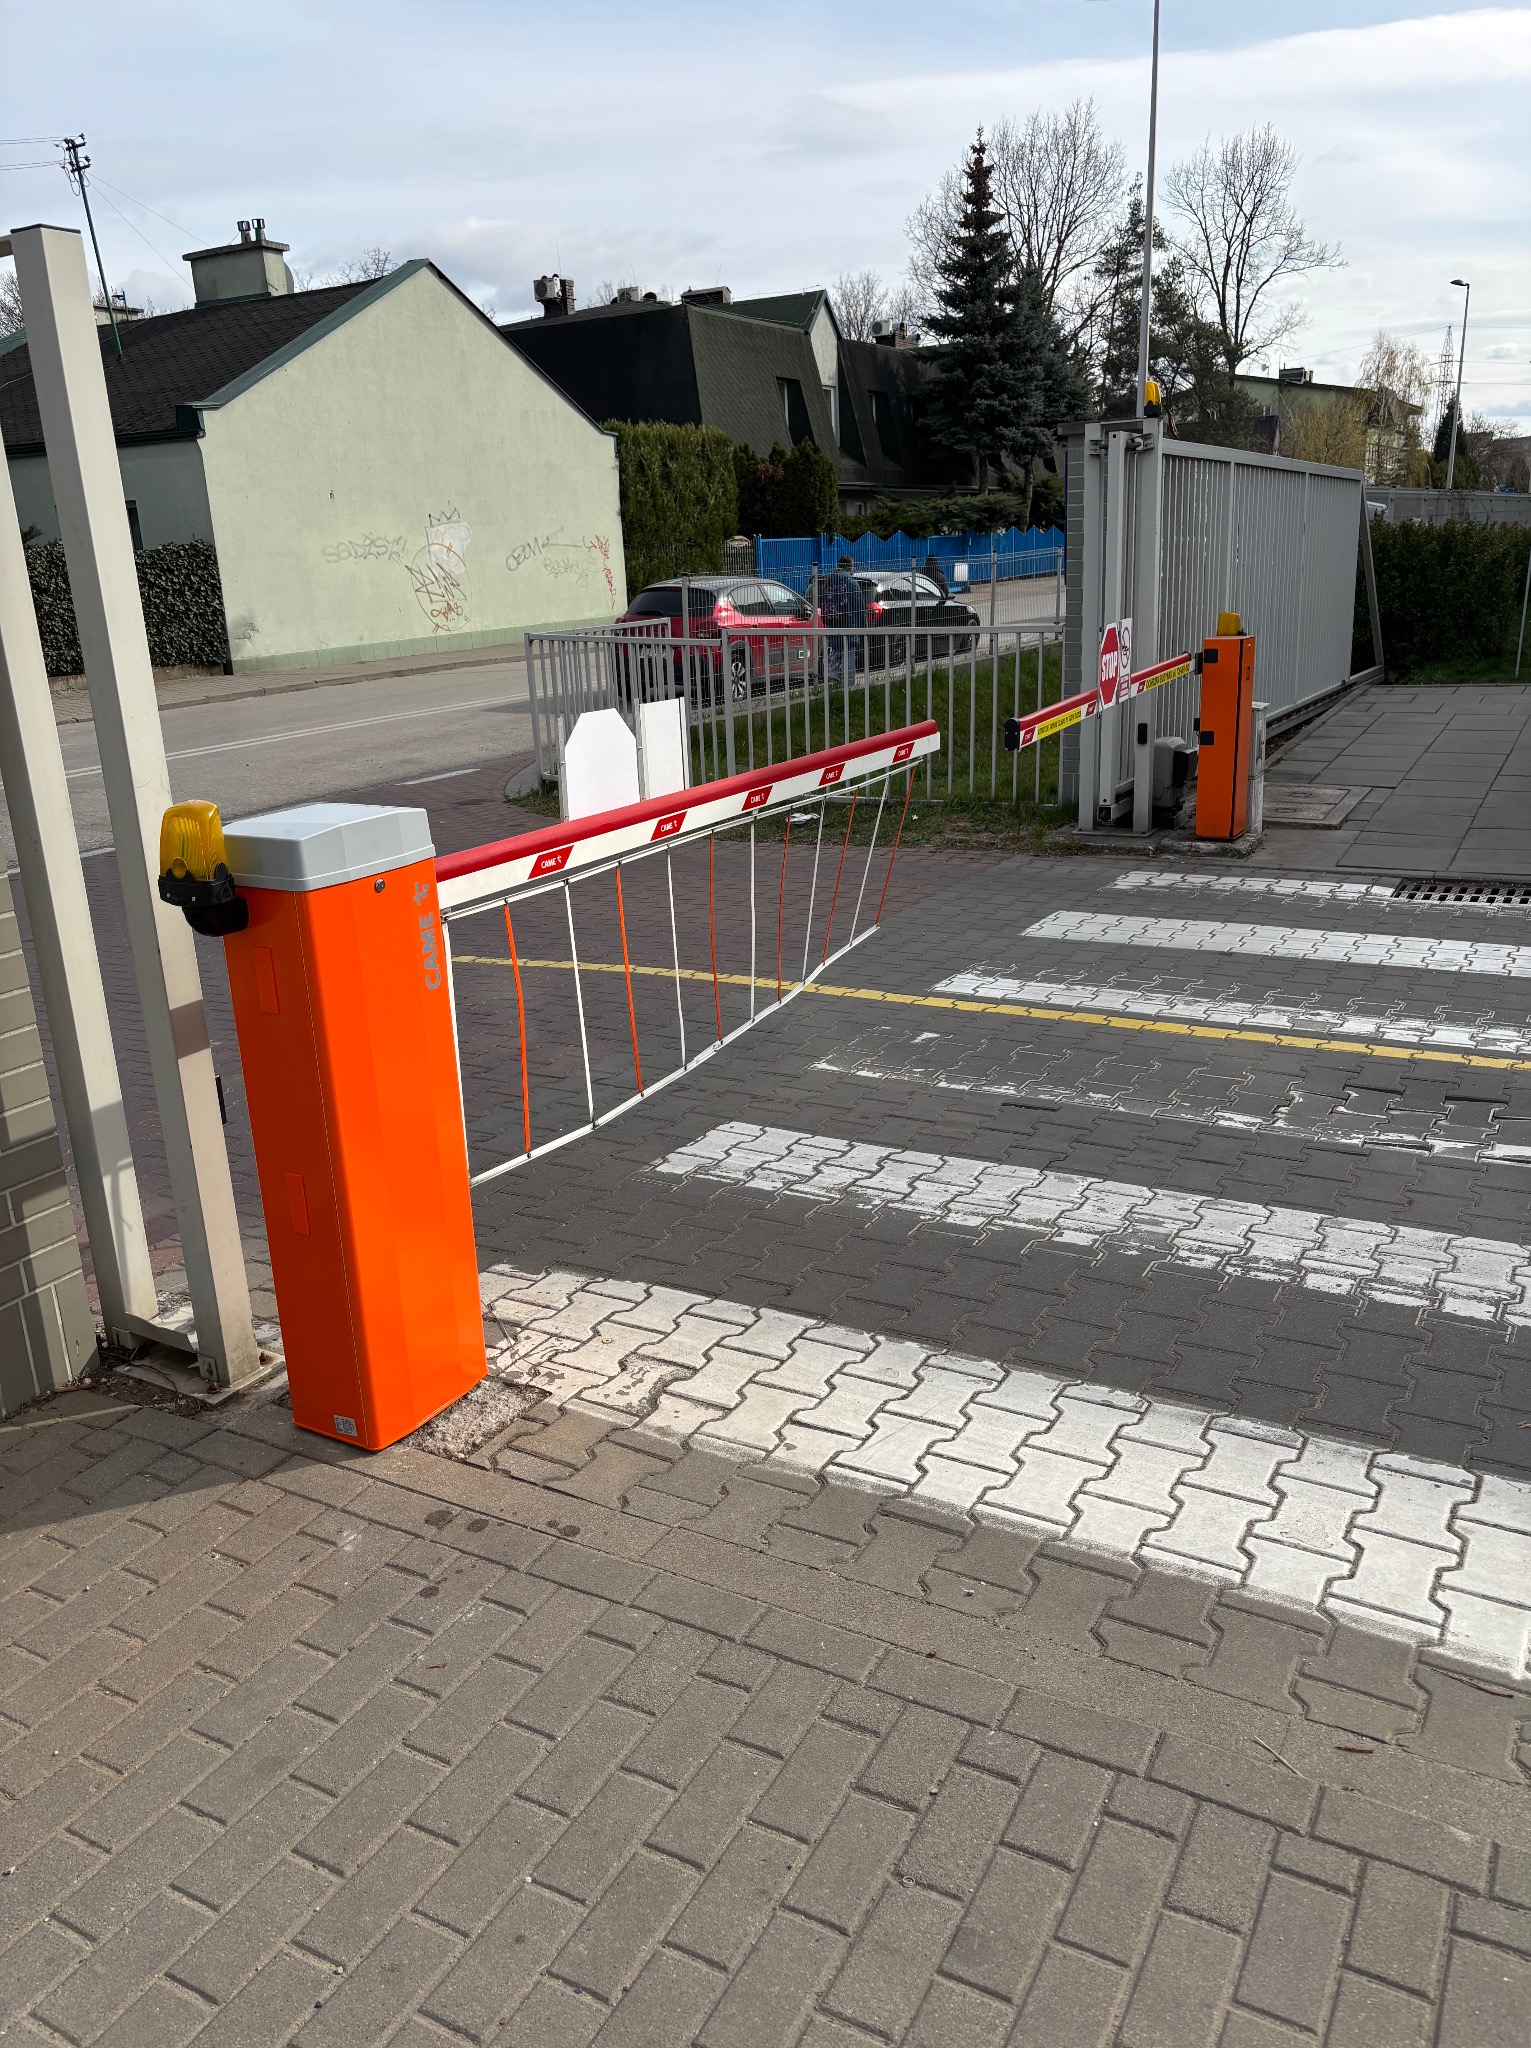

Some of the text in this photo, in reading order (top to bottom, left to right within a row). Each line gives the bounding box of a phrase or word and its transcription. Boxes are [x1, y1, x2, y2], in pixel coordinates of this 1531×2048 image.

[1102, 651, 1117, 682] STOP
[750, 794, 761, 804] CAME
[660, 822, 673, 833] CAME
[541, 857, 557, 869] CAME
[419, 911, 441, 990] CAME
